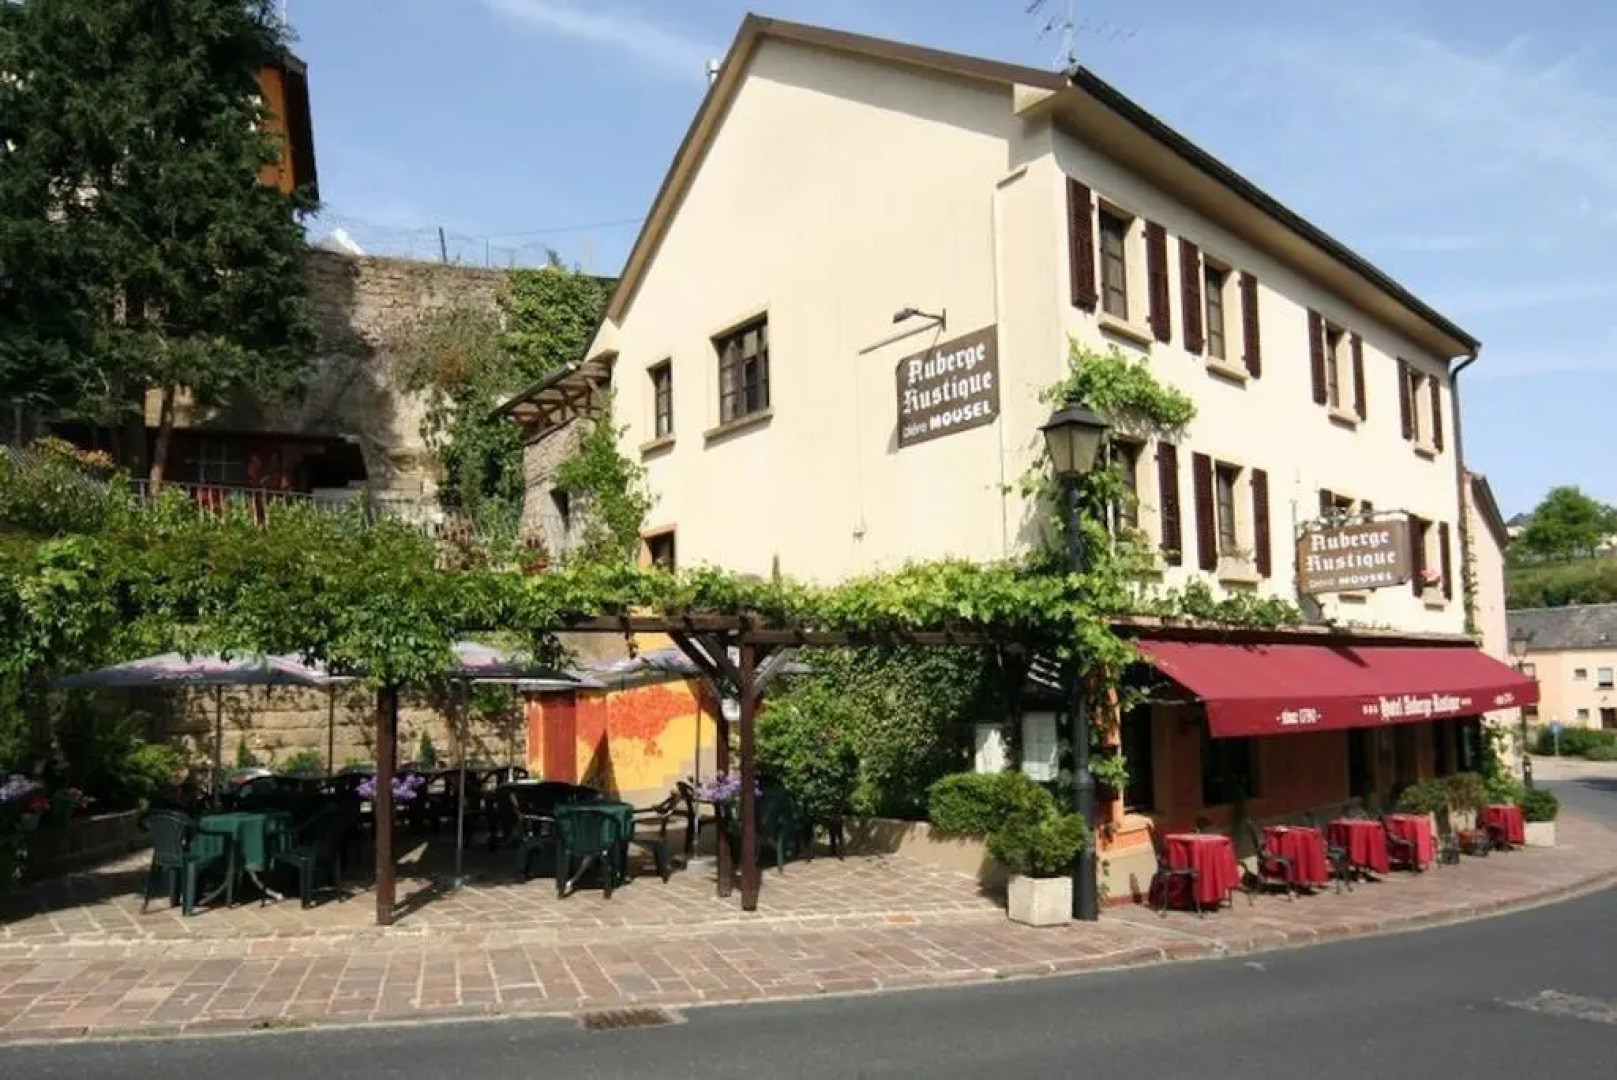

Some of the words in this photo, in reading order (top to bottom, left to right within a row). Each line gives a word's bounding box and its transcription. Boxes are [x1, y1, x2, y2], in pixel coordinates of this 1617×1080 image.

[908, 343, 986, 386] Auberge
[903, 371, 993, 414] Rustique
[929, 400, 992, 430] MOUSEL
[1311, 531, 1390, 551] Auberge
[1306, 551, 1397, 571] Rustique
